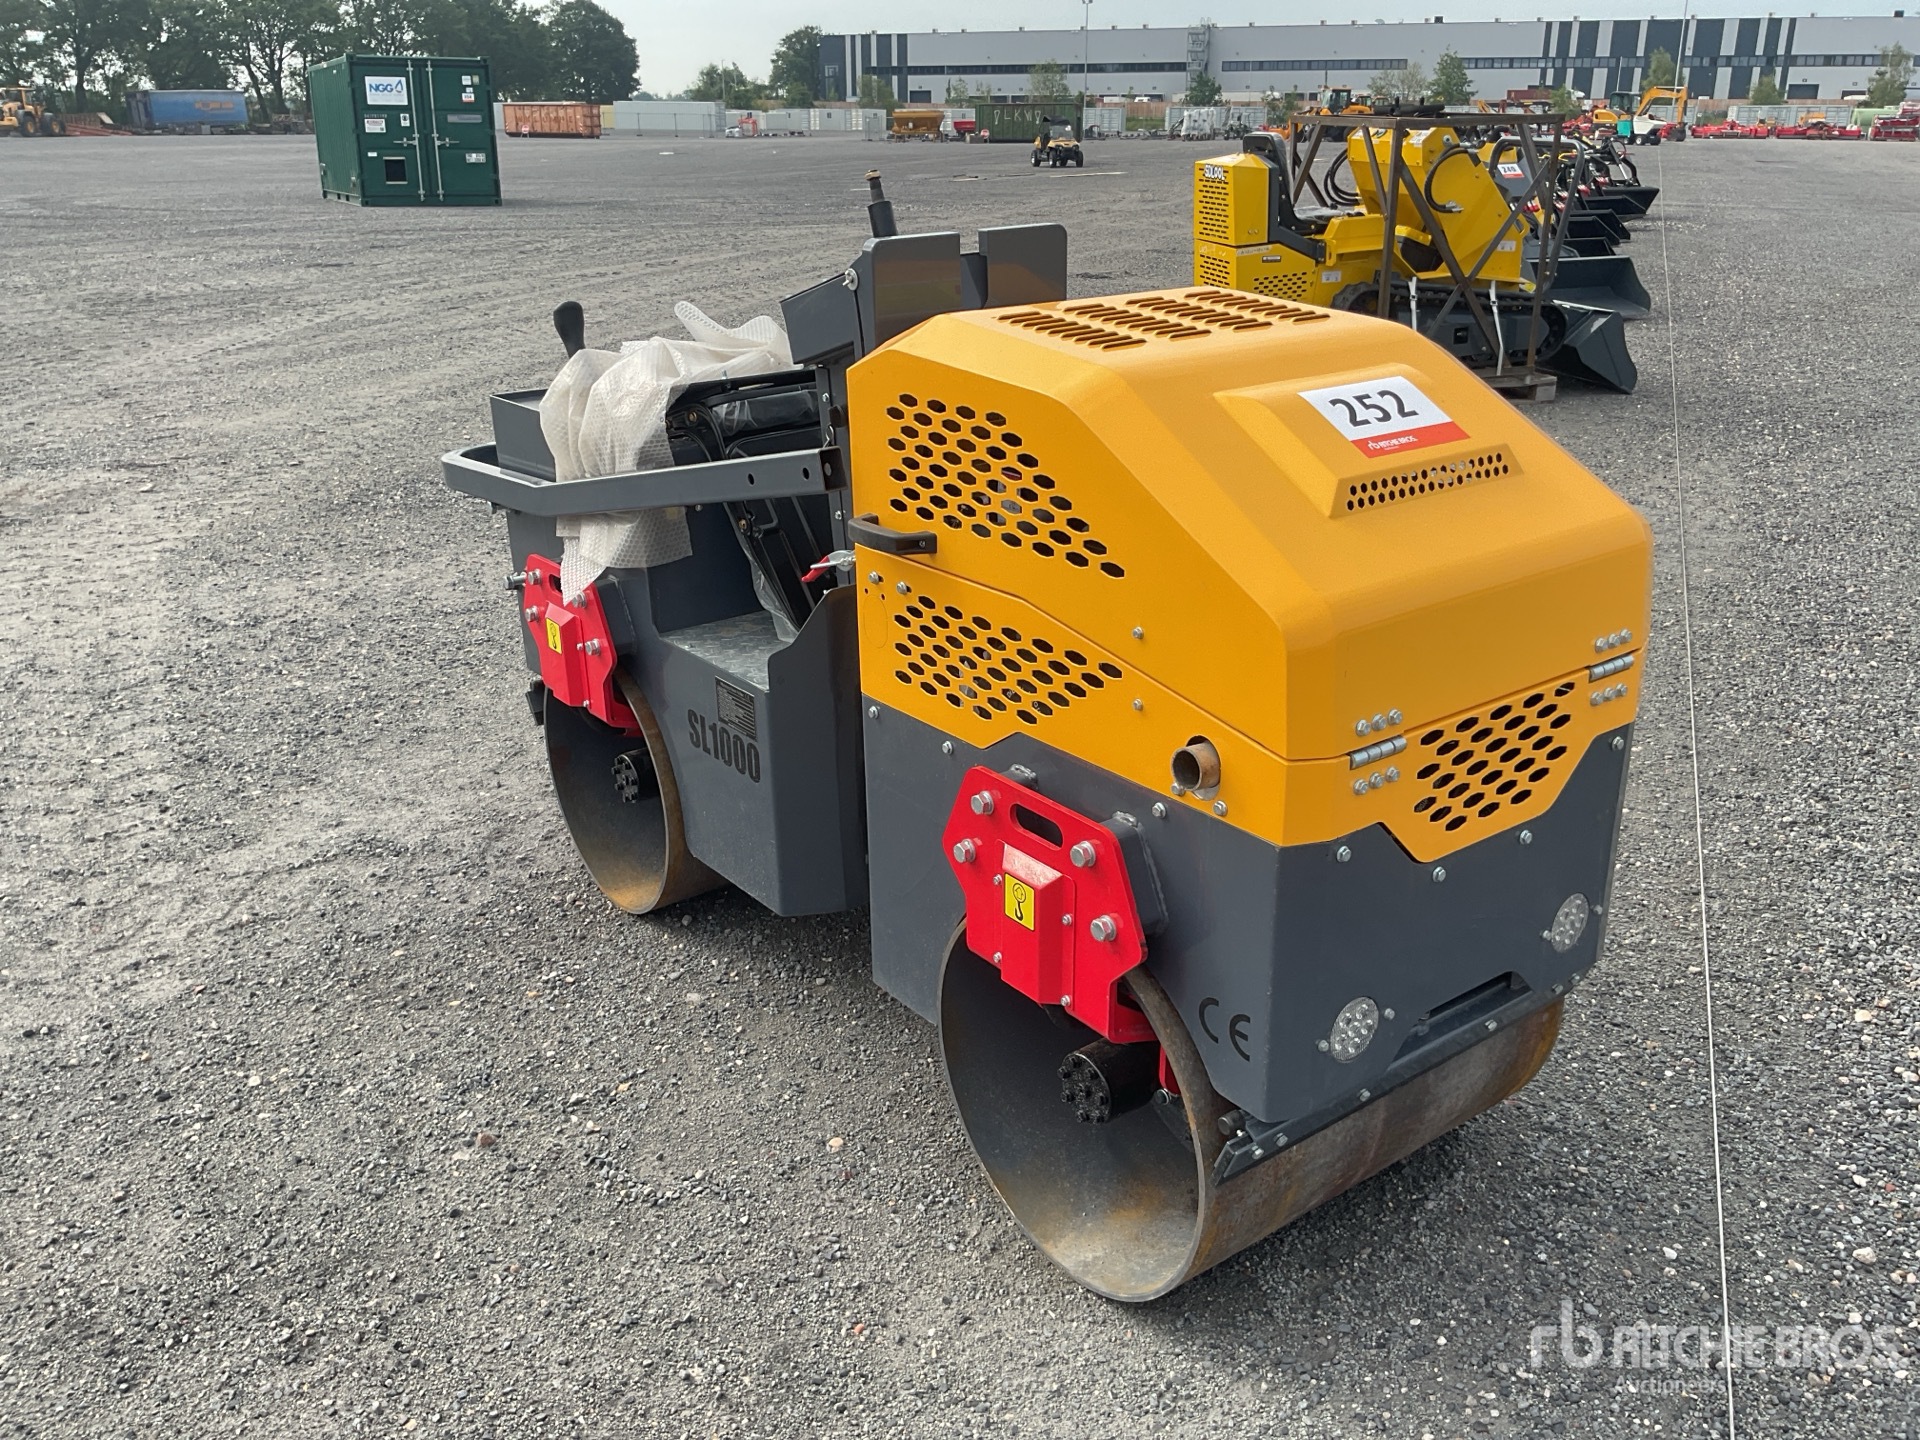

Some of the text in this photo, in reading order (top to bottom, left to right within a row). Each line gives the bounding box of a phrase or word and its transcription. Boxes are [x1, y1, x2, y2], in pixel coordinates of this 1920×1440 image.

[369, 83, 394, 93] NGG
[1329, 389, 1419, 427] 252
[687, 708, 761, 784] SL1000
[1198, 996, 1251, 1063] CE
